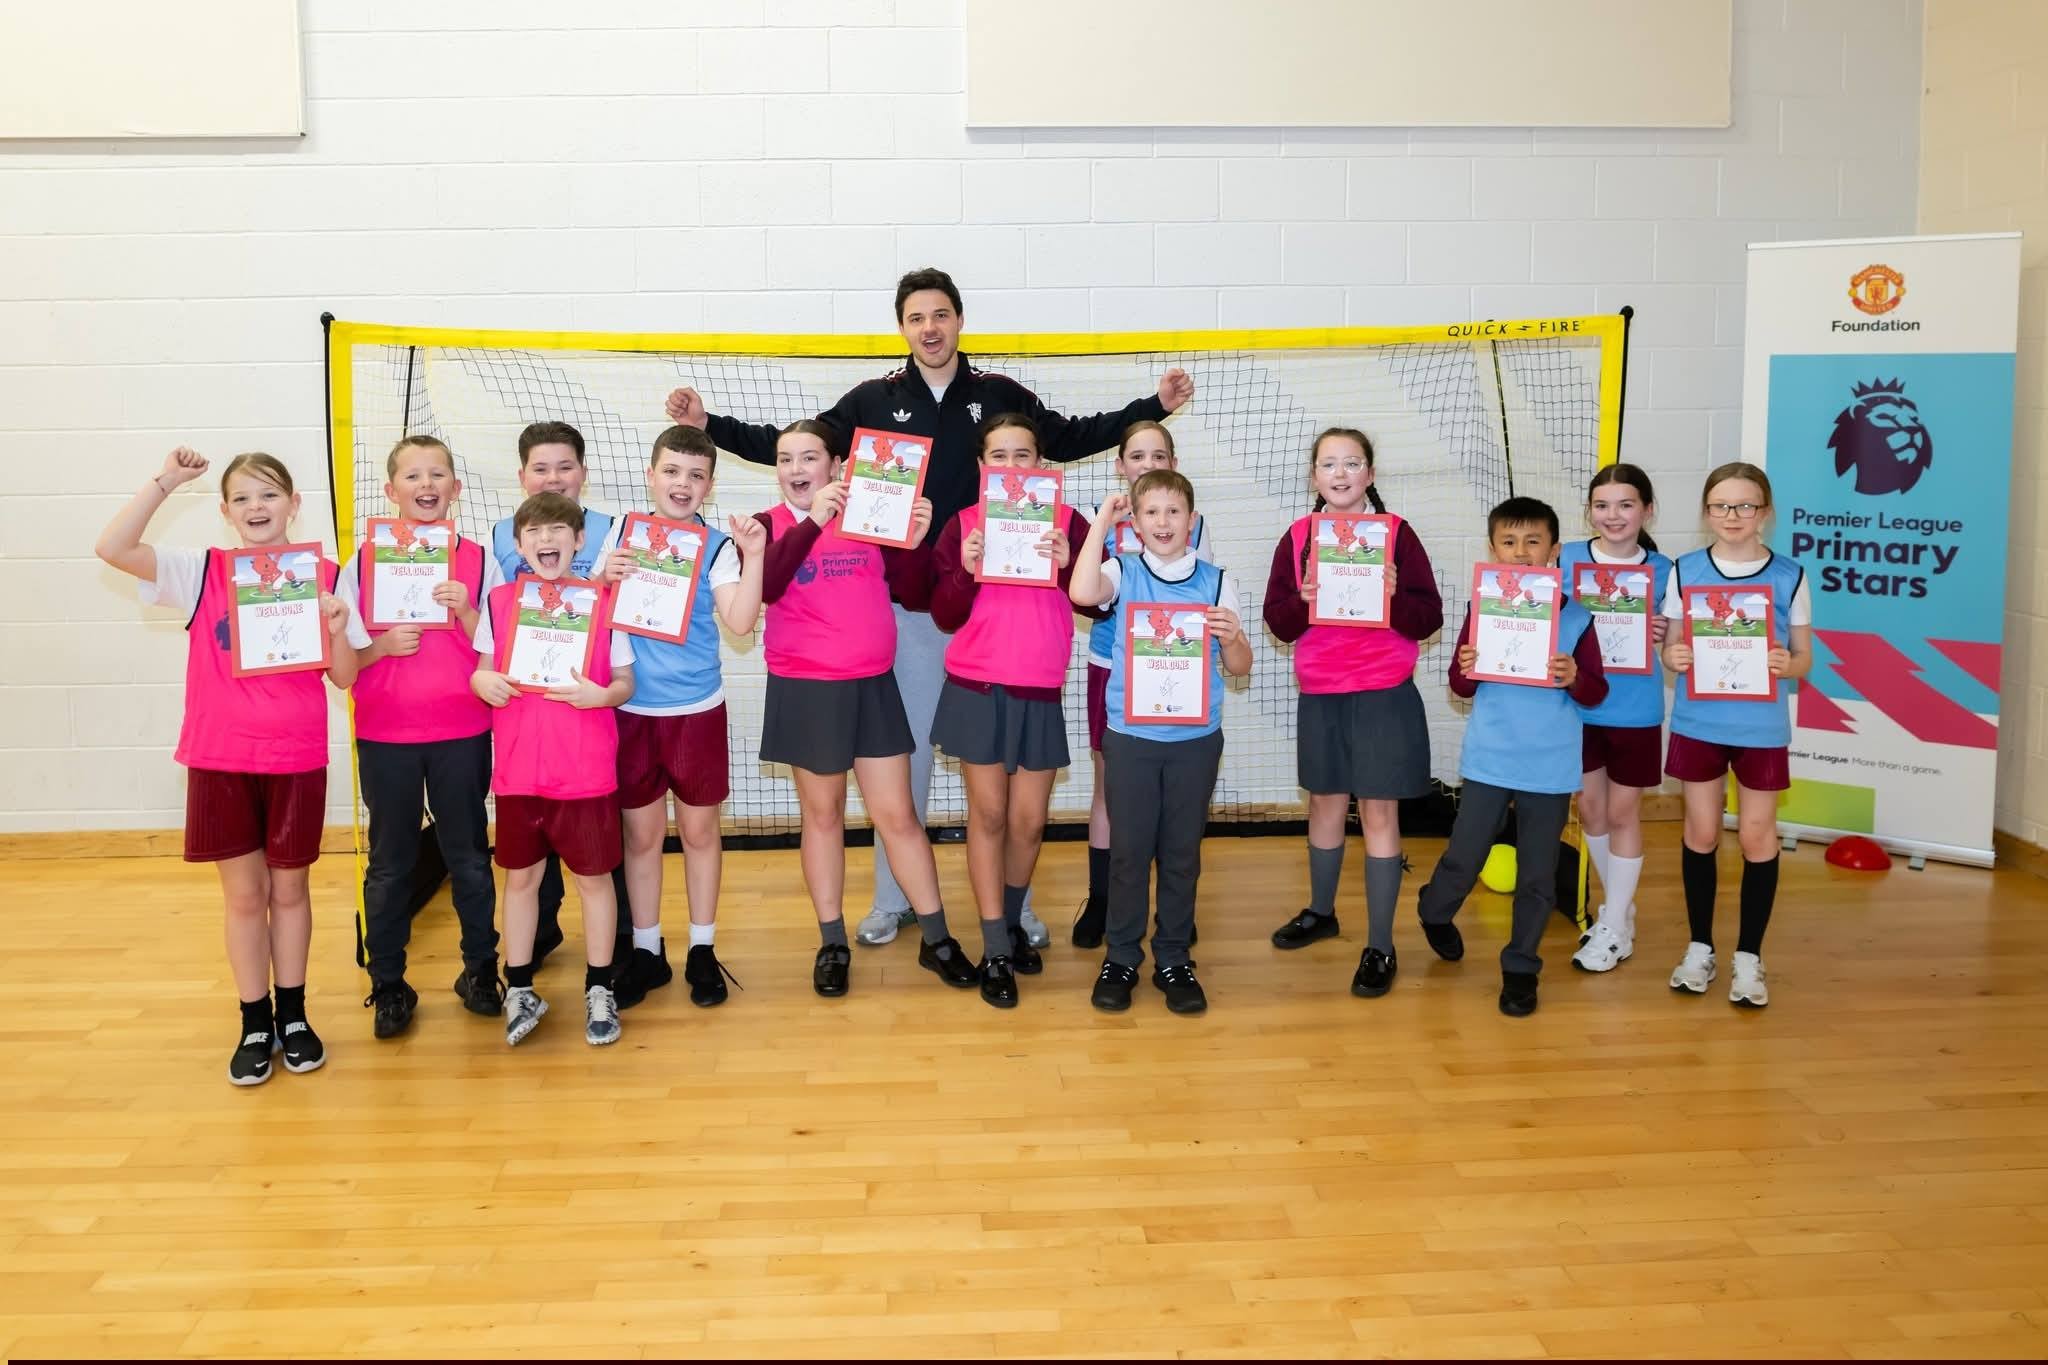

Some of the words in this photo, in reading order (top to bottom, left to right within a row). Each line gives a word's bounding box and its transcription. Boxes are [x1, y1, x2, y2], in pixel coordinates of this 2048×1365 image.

[1447, 323, 1508, 337] QUICK
[1540, 320, 1582, 333] FIRE
[1831, 320, 1920, 332] Foundation
[1793, 508, 1871, 529] Premier
[1879, 512, 1963, 536] League
[1792, 531, 1959, 574] Primary
[822, 557, 869, 568] Primary
[823, 568, 855, 577] Stars
[1821, 566, 1928, 598] Stars
[1813, 752, 1849, 764] League
[1852, 757, 1876, 767] More
[1878, 760, 1901, 770] than
[1902, 764, 1910, 772] a
[286, 1022, 307, 1036] NIKE
